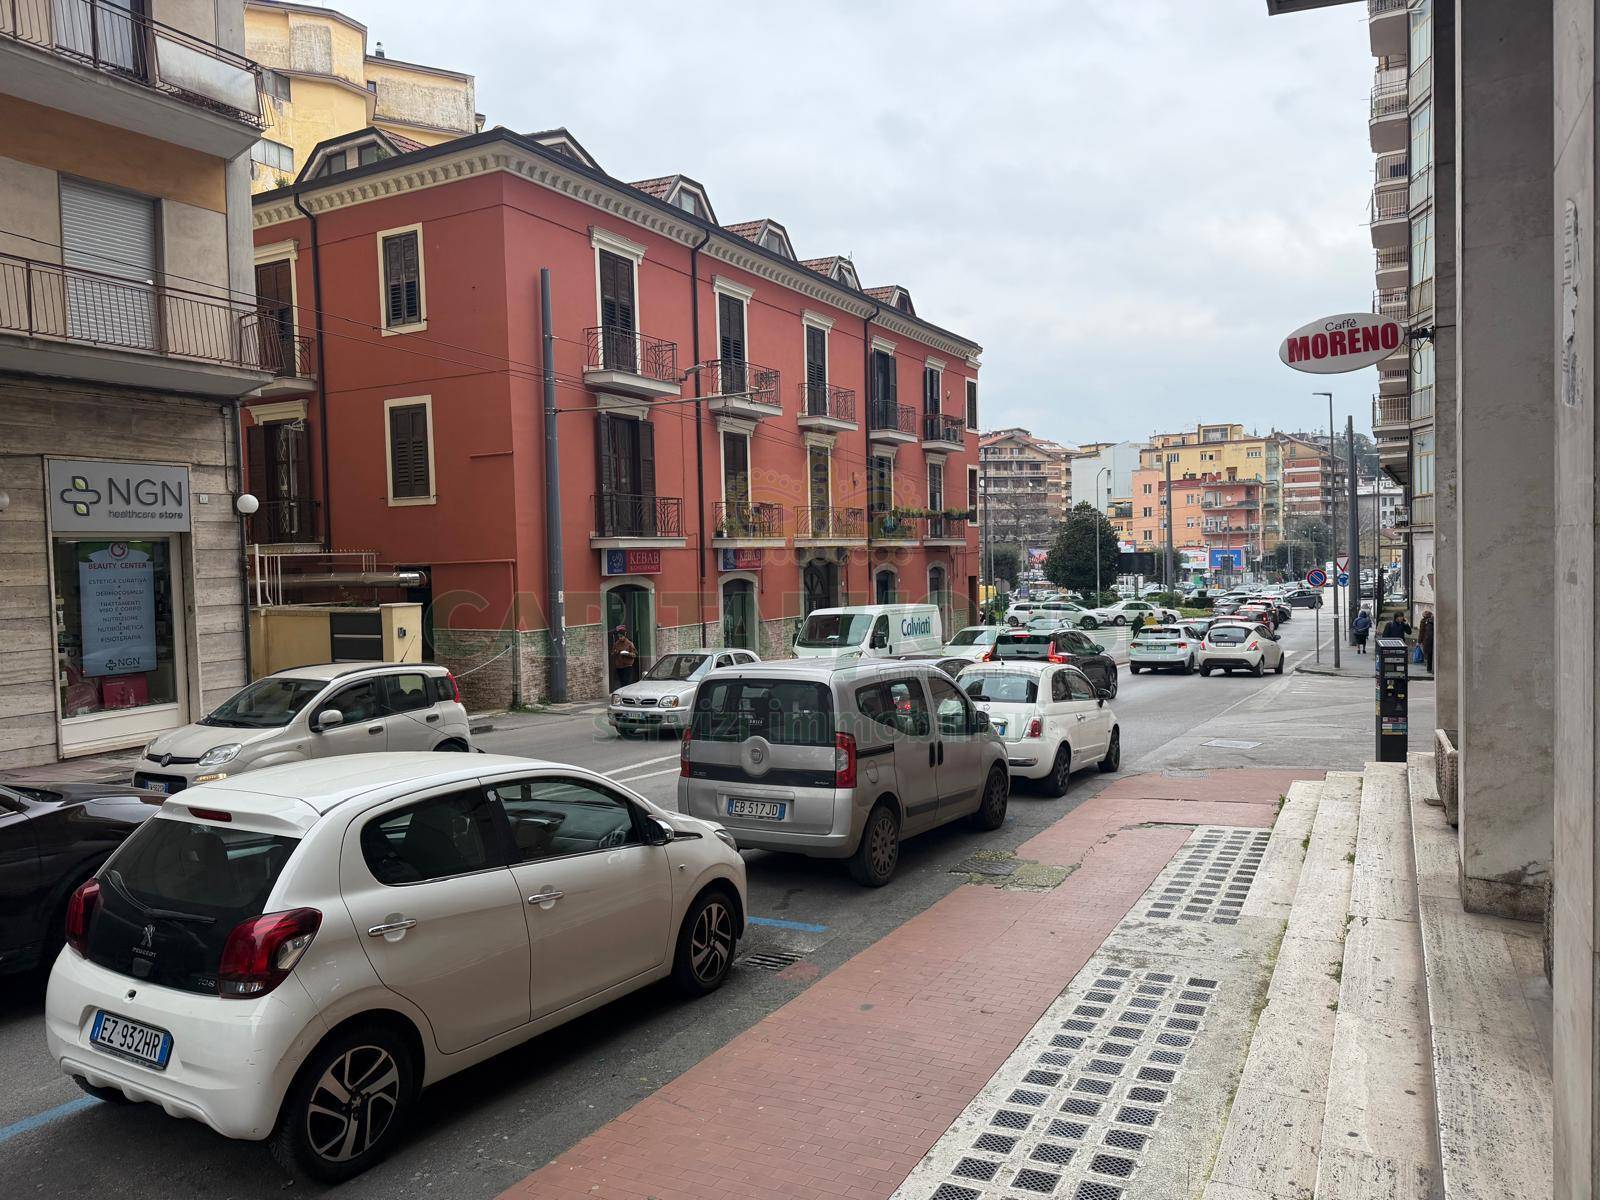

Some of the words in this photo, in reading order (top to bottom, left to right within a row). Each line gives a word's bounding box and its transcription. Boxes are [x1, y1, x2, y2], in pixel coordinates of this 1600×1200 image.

[1325, 318, 1357, 332] Caffè
[1286, 322, 1399, 363] MORENO
[107, 477, 183, 507] NGN
[108, 510, 156, 519] healthcare
[158, 511, 183, 519] store
[630, 551, 660, 564] KEBAB
[88, 562, 117, 570] BEAUTY
[901, 615, 931, 637] Calviati
[117, 657, 140, 667] NGN
[733, 801, 746, 814] EB
[747, 802, 778, 817] 517JD
[99, 1017, 119, 1045] EZ
[121, 1023, 161, 1061] 932HR
